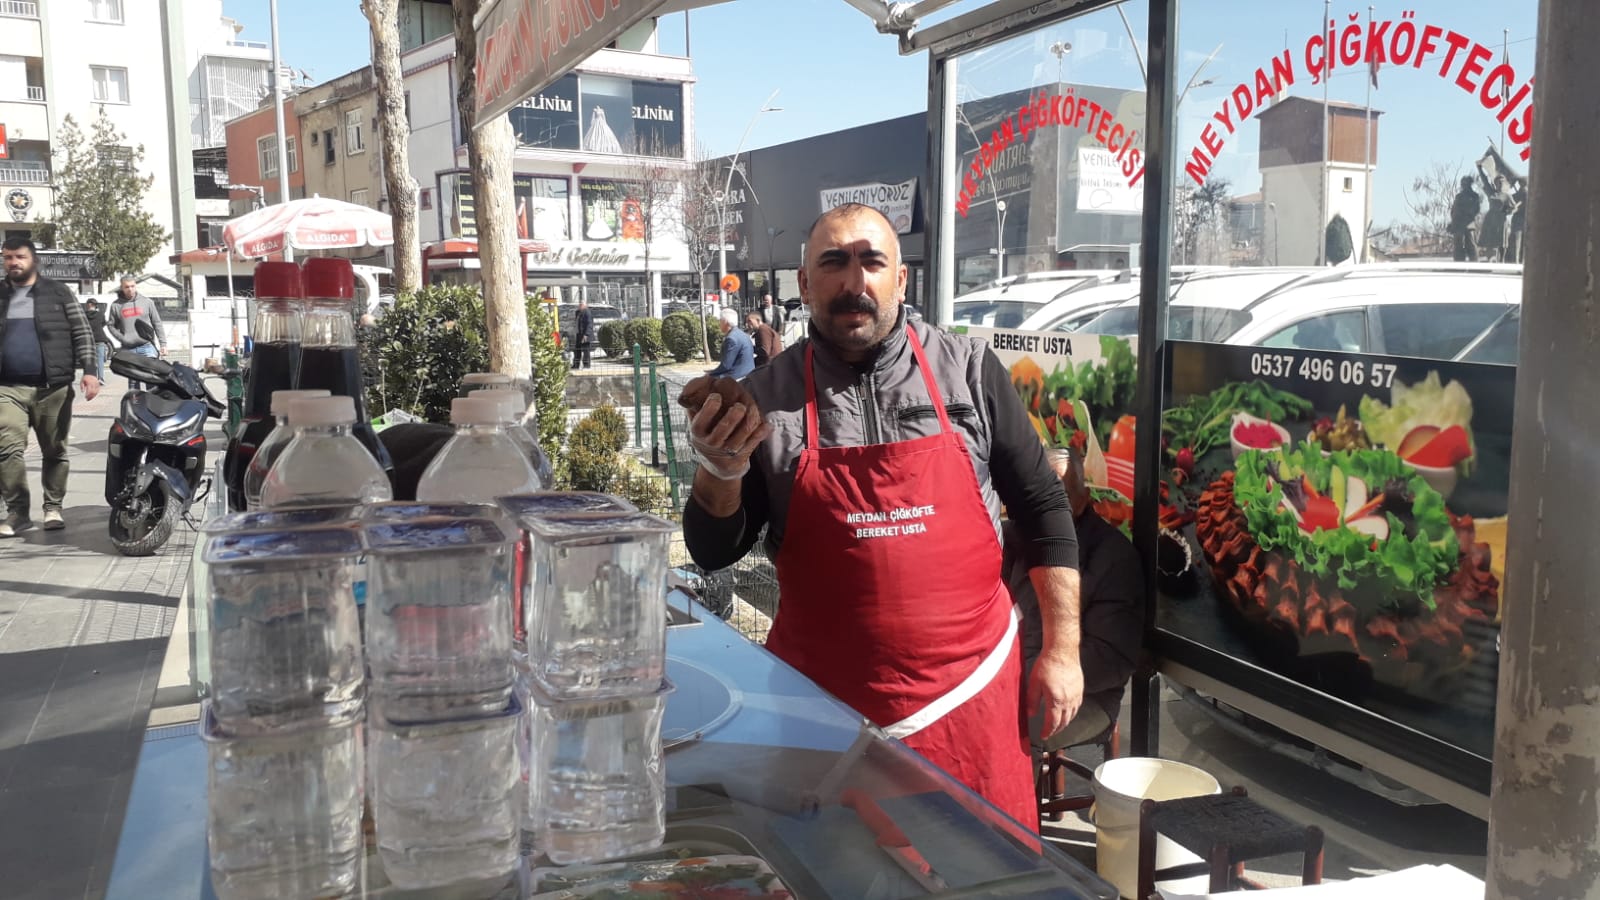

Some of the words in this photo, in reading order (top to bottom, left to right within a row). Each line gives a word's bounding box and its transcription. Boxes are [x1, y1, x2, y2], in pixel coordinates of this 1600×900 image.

[514, 94, 573, 113] ELİNİM
[1184, 50, 1295, 186] MEYDAN
[1305, 11, 1536, 162] ÇİĞKÖFTECİS
[956, 116, 1014, 218] MEYDAN
[993, 333, 1040, 352] BEREKET
[1043, 336, 1072, 355] USTA
[1251, 353, 1294, 378] 0537
[1299, 357, 1334, 382] 496
[1340, 360, 1365, 385] 06
[1371, 363, 1398, 388] 57
[847, 512, 886, 523] MEYDAN
[890, 505, 936, 523] ÇİĞKÖFTE
[856, 526, 900, 538] BEREKET
[902, 522, 927, 535] USTA
